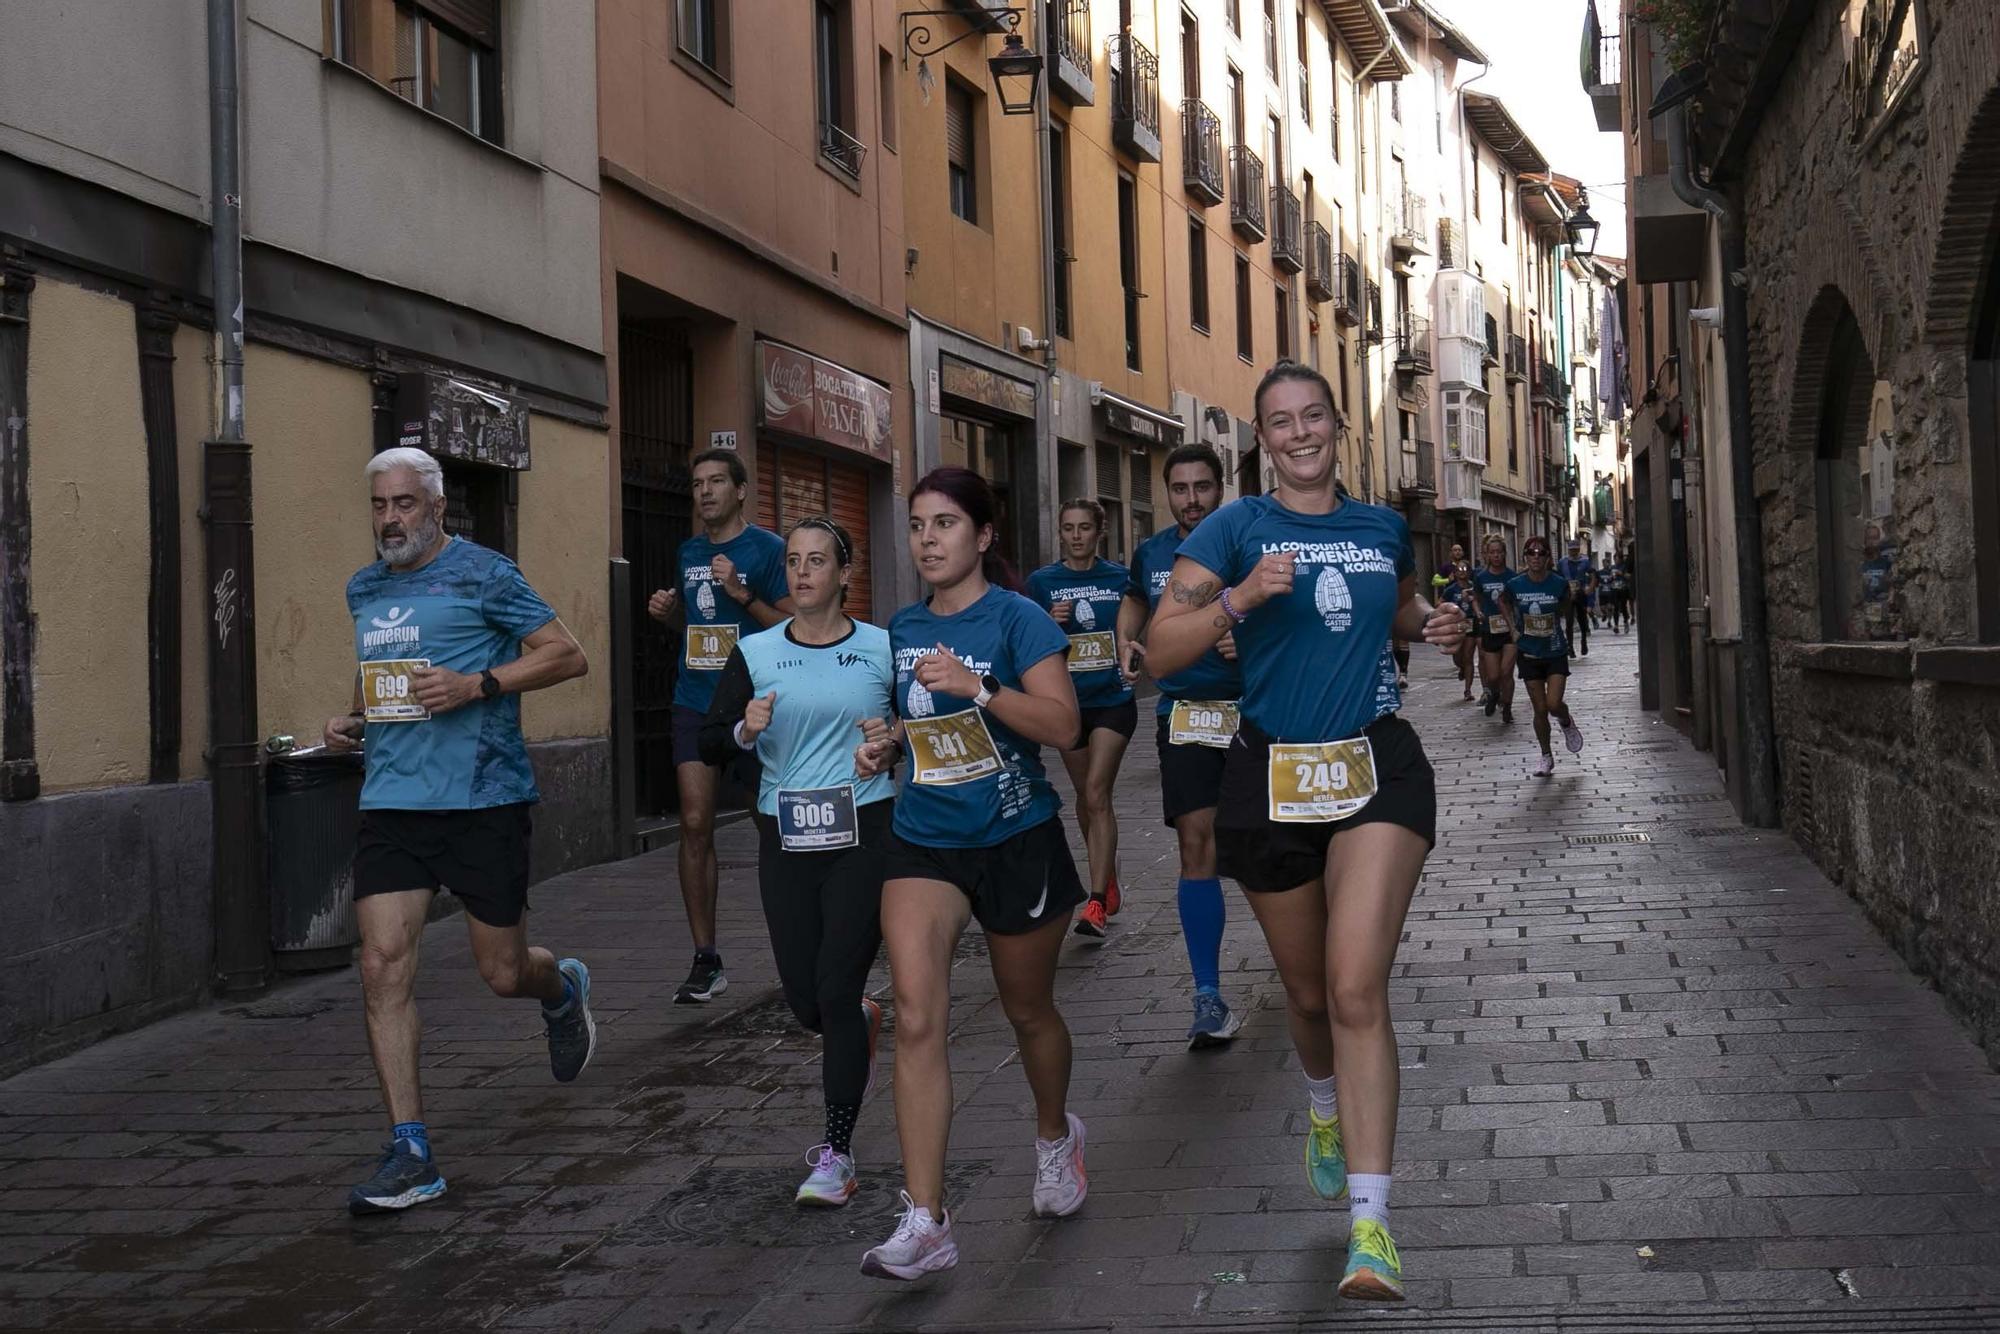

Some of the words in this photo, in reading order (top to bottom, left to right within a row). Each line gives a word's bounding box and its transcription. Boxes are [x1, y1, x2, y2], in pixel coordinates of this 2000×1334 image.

[713, 434, 735, 446] 46
[1262, 543, 1279, 554] LA
[1280, 541, 1357, 552] CONQUISTA
[1060, 586, 1097, 595] CONQUISTA
[1062, 589, 1112, 601] ALMENDRA
[702, 636, 719, 653] 40
[1078, 641, 1102, 657] 273
[375, 675, 408, 698] 699
[1188, 710, 1223, 729] 509
[927, 731, 968, 760] 341
[1295, 761, 1349, 793] 249
[792, 802, 836, 828] 906
